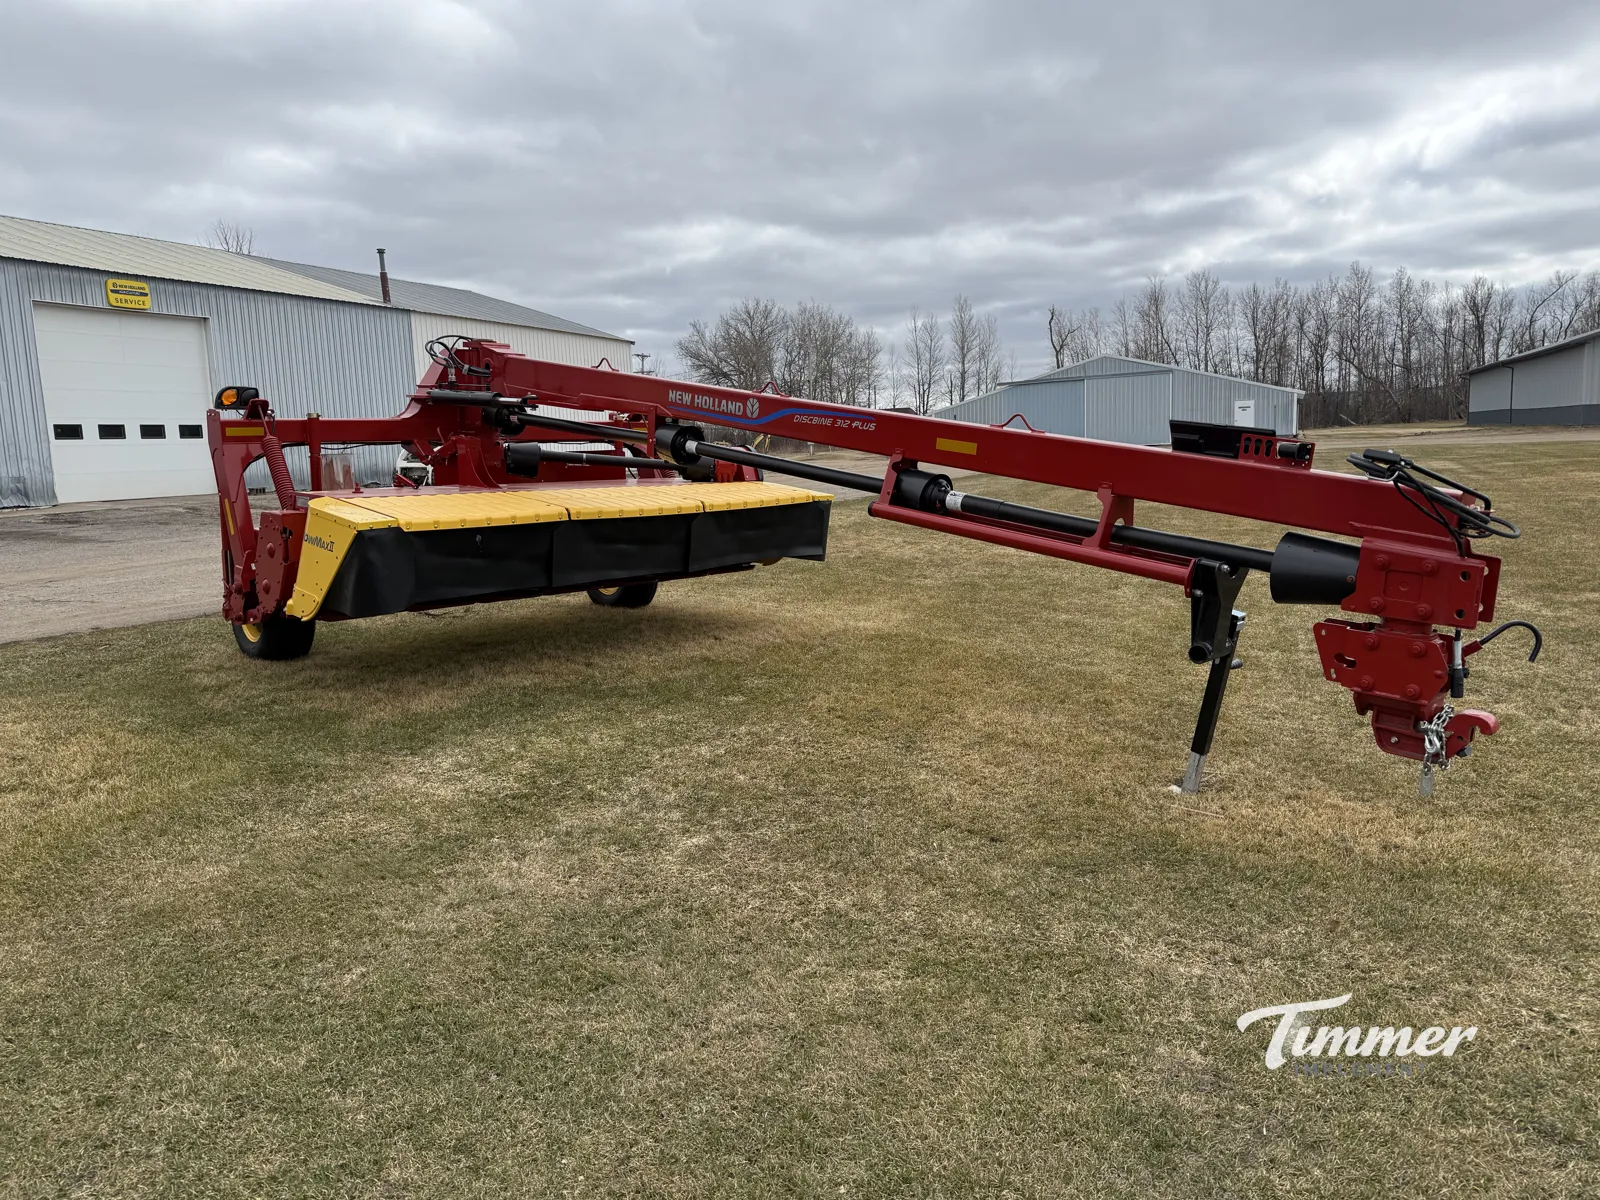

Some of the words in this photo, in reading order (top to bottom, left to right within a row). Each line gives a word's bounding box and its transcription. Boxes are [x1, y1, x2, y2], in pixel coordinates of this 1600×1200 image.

[114, 298, 146, 306] SERVICE
[668, 389, 692, 406] NEW
[694, 394, 744, 416] HOLLAND
[793, 414, 834, 426] DISCBINE
[834, 419, 851, 428] 312
[851, 420, 877, 431] PLUS
